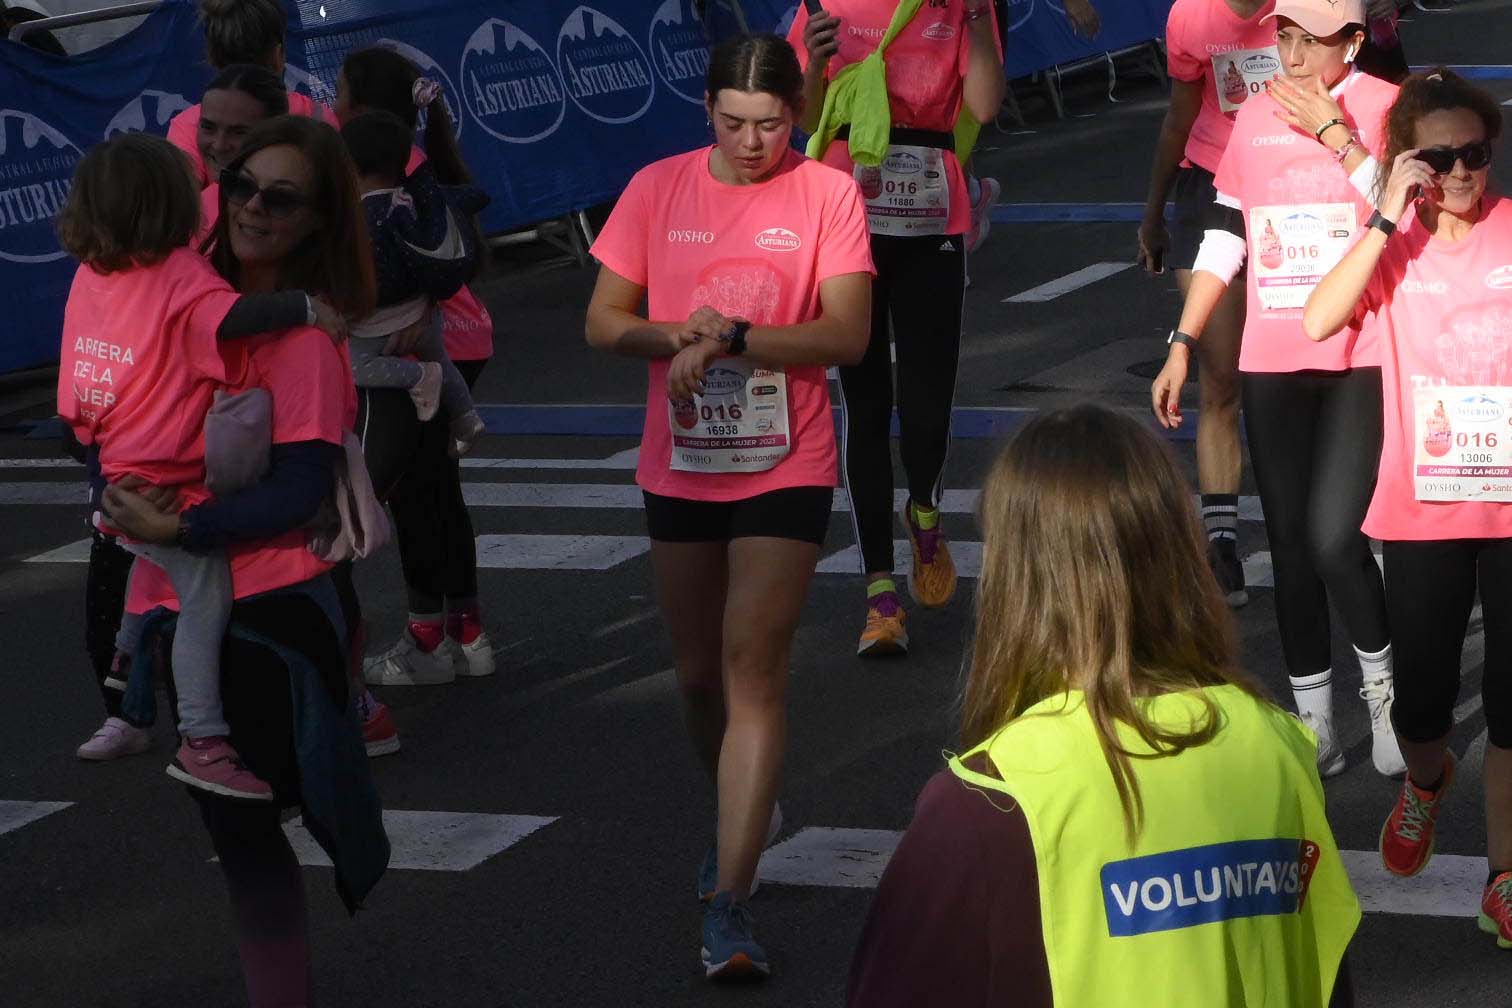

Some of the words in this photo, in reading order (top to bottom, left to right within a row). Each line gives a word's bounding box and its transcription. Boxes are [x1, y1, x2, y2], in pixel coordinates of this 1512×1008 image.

[885, 180, 918, 194] 016
[668, 230, 714, 244] OYSHO
[1287, 244, 1319, 259] 016
[701, 403, 742, 420] 016
[706, 425, 739, 435] 16938
[1456, 432, 1498, 448] 016
[1461, 453, 1493, 463] 13006
[1424, 483, 1461, 492] OYSHO
